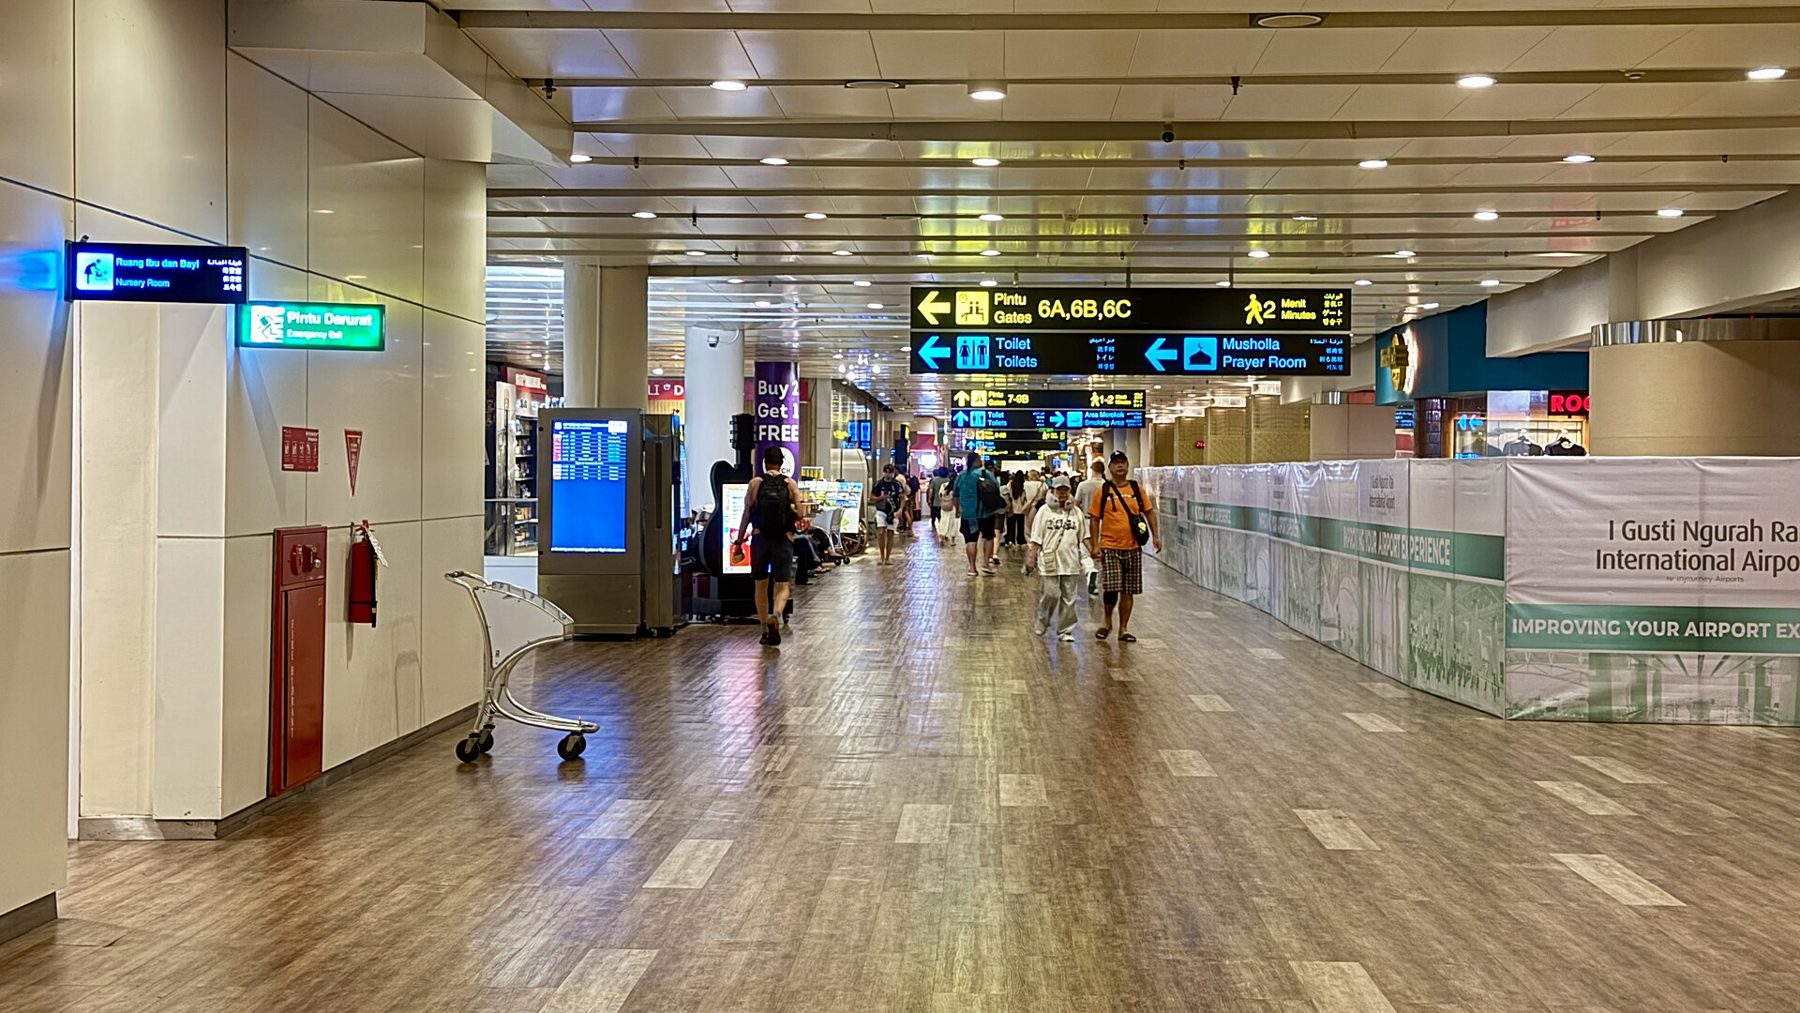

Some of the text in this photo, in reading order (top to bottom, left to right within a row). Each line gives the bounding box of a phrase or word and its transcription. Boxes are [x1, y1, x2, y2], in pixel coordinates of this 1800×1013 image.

[115, 257, 144, 269] Ruang
[146, 258, 160, 268] Ibu
[161, 259, 178, 268] dan
[116, 278, 170, 288] Nursery Room
[994, 293, 1027, 306] Pintu
[1281, 298, 1306, 308] Menit
[1038, 299, 1132, 320] 6A,6B,6C
[1263, 300, 1276, 319] 2
[1281, 310, 1316, 320] Minutes
[287, 311, 373, 326] Pintu Darurat
[994, 311, 1032, 324] Gates
[995, 337, 1031, 350] Toilet
[1222, 338, 1280, 350] Musholla
[995, 355, 1038, 368] Toilets
[1222, 356, 1307, 370] Prayer Room
[758, 380, 799, 400] Buy 2
[758, 402, 788, 418] Get
[758, 424, 799, 442] FREE
[1609, 518, 1800, 547] I Gusti Ngurah Ra
[1596, 548, 1800, 578] International Airpo
[1512, 618, 1800, 638] IMPROVING YOUR AIRPORT EX
